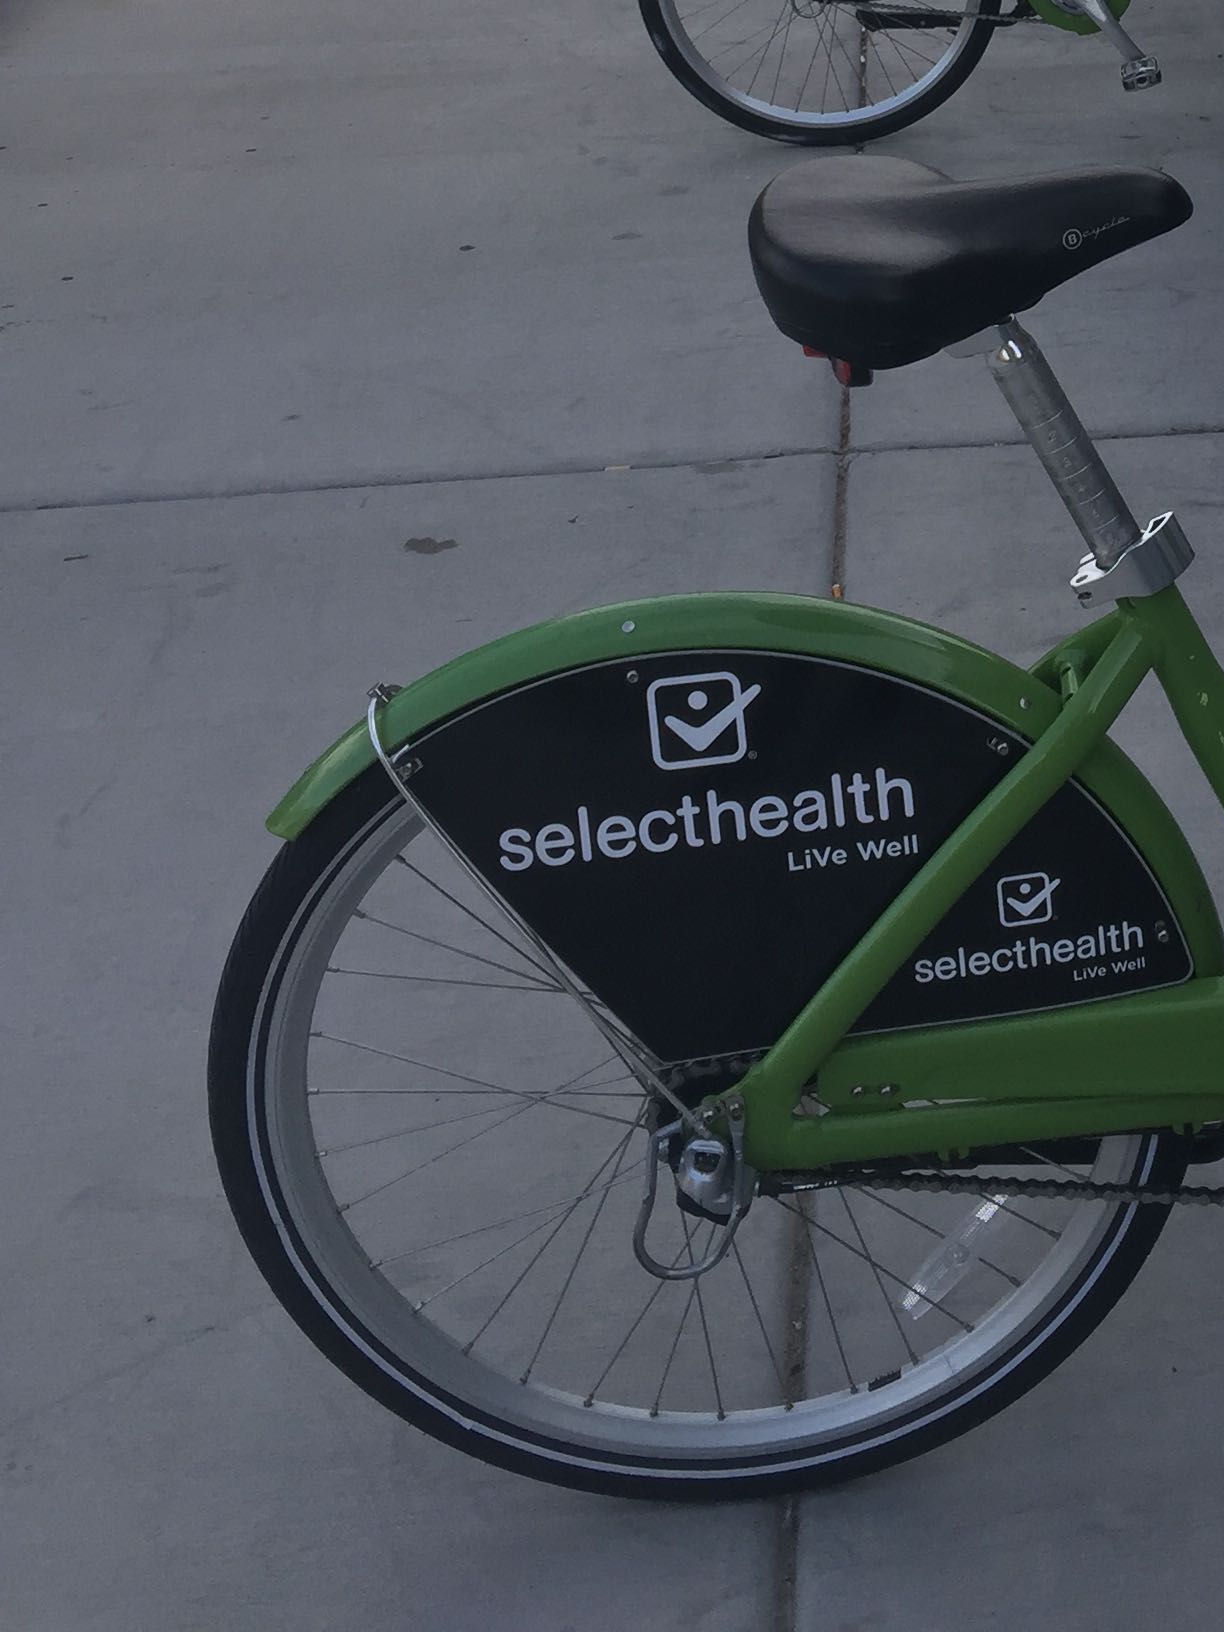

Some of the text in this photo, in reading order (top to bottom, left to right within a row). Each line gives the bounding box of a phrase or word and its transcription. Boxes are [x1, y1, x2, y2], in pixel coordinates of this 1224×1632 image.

[499, 767, 915, 871] selecthealth
[787, 834, 919, 871] LiVe Well
[914, 921, 1144, 983] selecthealth
[1111, 956, 1146, 974] Well
